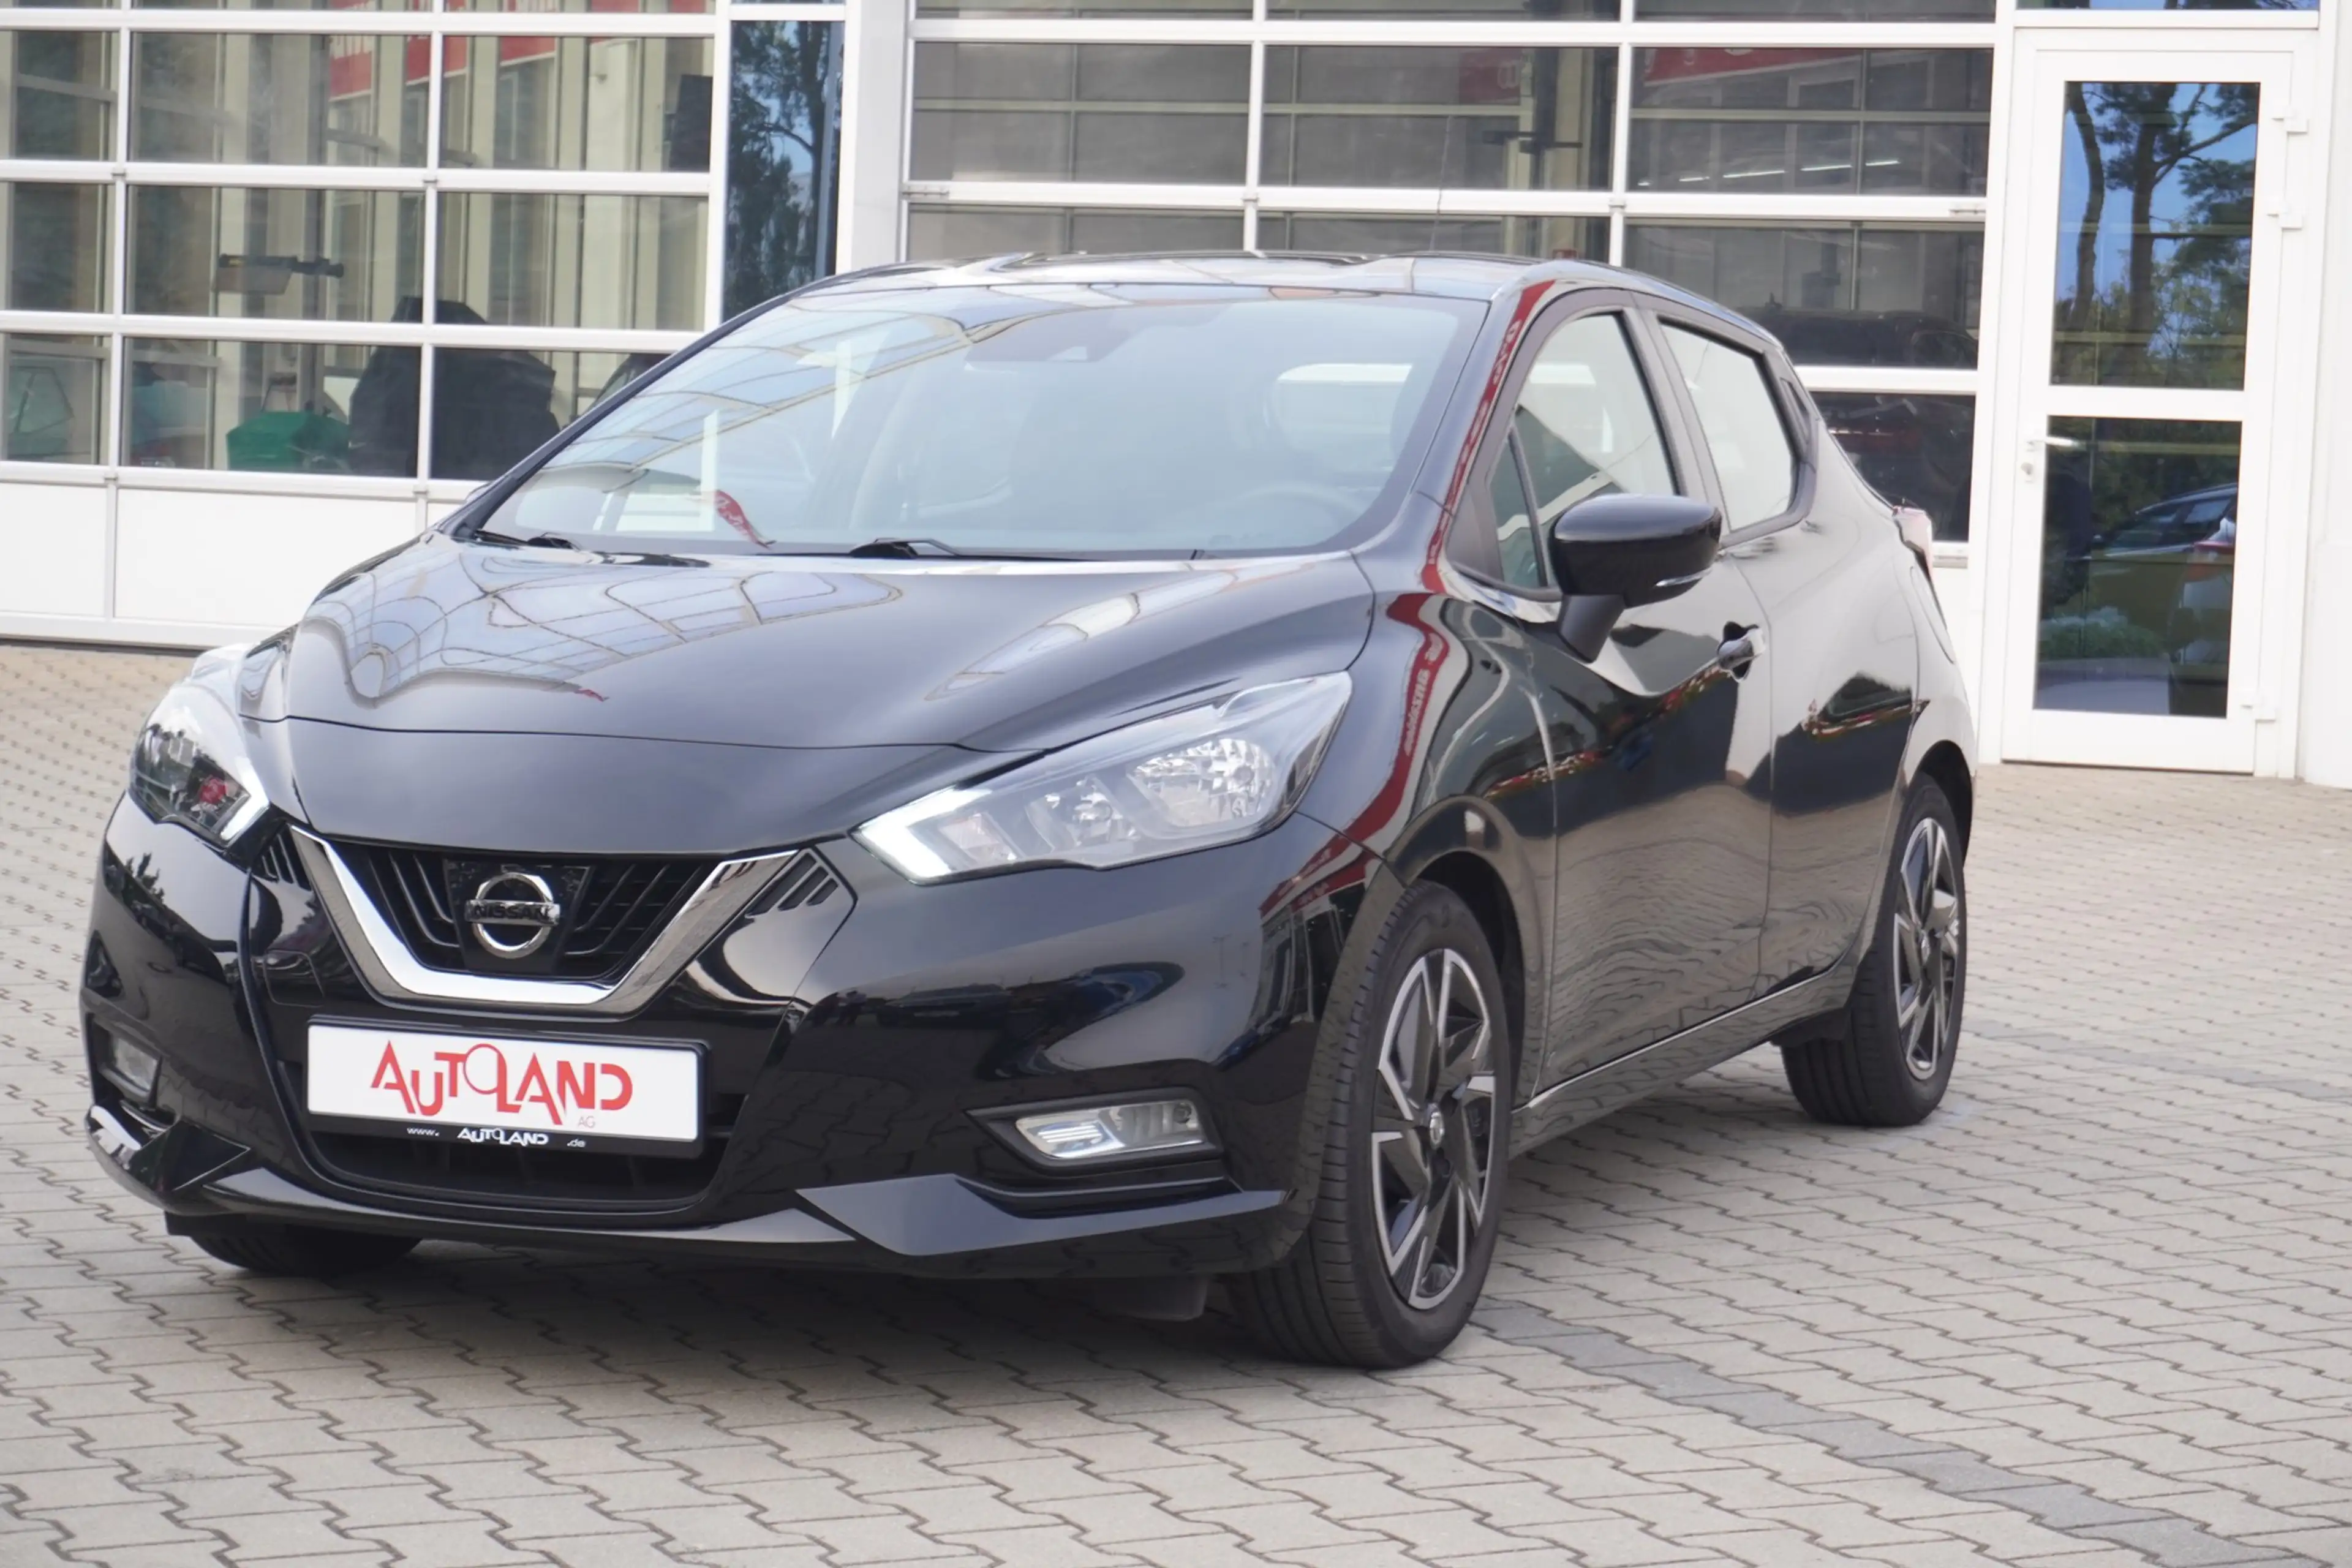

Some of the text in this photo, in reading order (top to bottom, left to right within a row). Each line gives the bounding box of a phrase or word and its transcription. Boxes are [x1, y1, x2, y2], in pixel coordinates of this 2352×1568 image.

[473, 905, 551, 921] NISSAN
[371, 1041, 633, 1125] AUTOLAND
[577, 1115, 595, 1128] AG
[406, 1127, 586, 1147] www. AUTOLAND .de
